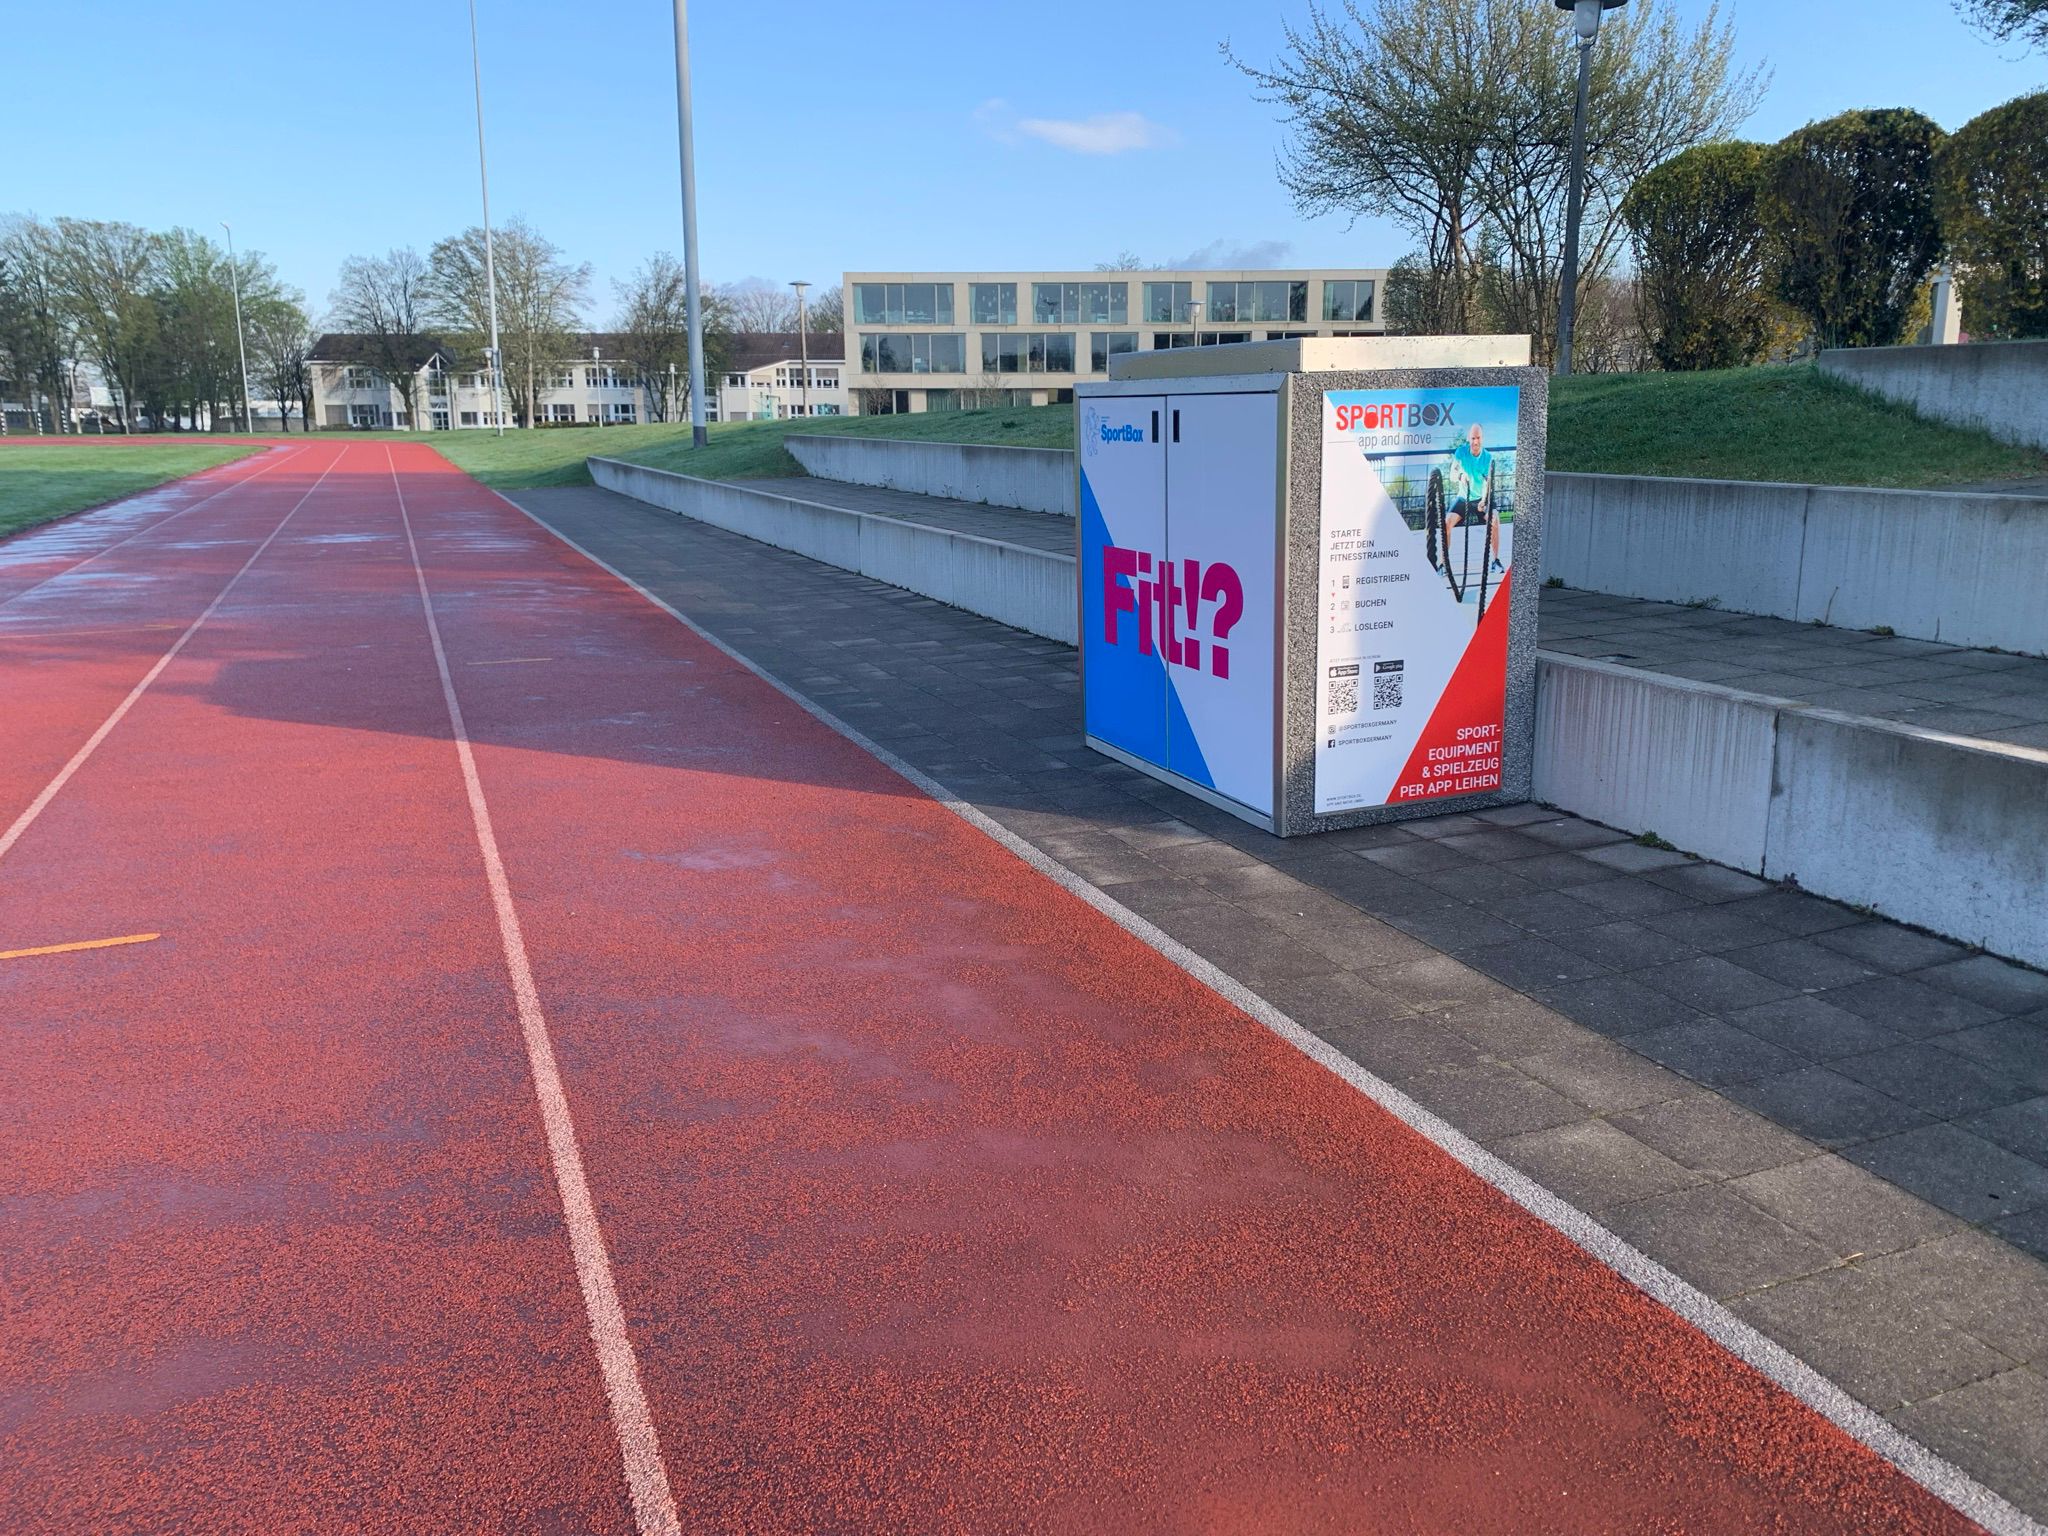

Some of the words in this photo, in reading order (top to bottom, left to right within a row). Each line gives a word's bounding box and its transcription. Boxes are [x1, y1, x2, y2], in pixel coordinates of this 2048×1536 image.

[1336, 402, 1455, 430] SPORTBOX
[1100, 423, 1144, 444] SportBox
[1358, 434, 1378, 448] app
[1381, 431, 1400, 446] and
[1403, 433, 1432, 445] move
[1331, 529, 1361, 538] STARTE
[1330, 542, 1354, 550] JETZT
[1357, 540, 1375, 549] DEIN
[1330, 550, 1399, 561] FITNESSTRAINING
[1356, 574, 1410, 585] REGISTRIEREN
[1355, 599, 1386, 608] BUCHEN
[1103, 545, 1244, 680] Fit!?
[1355, 621, 1394, 632] LOSLEGEN
[1457, 725, 1501, 740] SPORT-
[1429, 741, 1500, 761] EQUIPMENT
[1422, 767, 1430, 778] &
[1433, 758, 1499, 777] SPIELZEUG
[1400, 783, 1424, 797] PER
[1427, 781, 1452, 794] APP
[1455, 774, 1498, 790] LEIHEN
